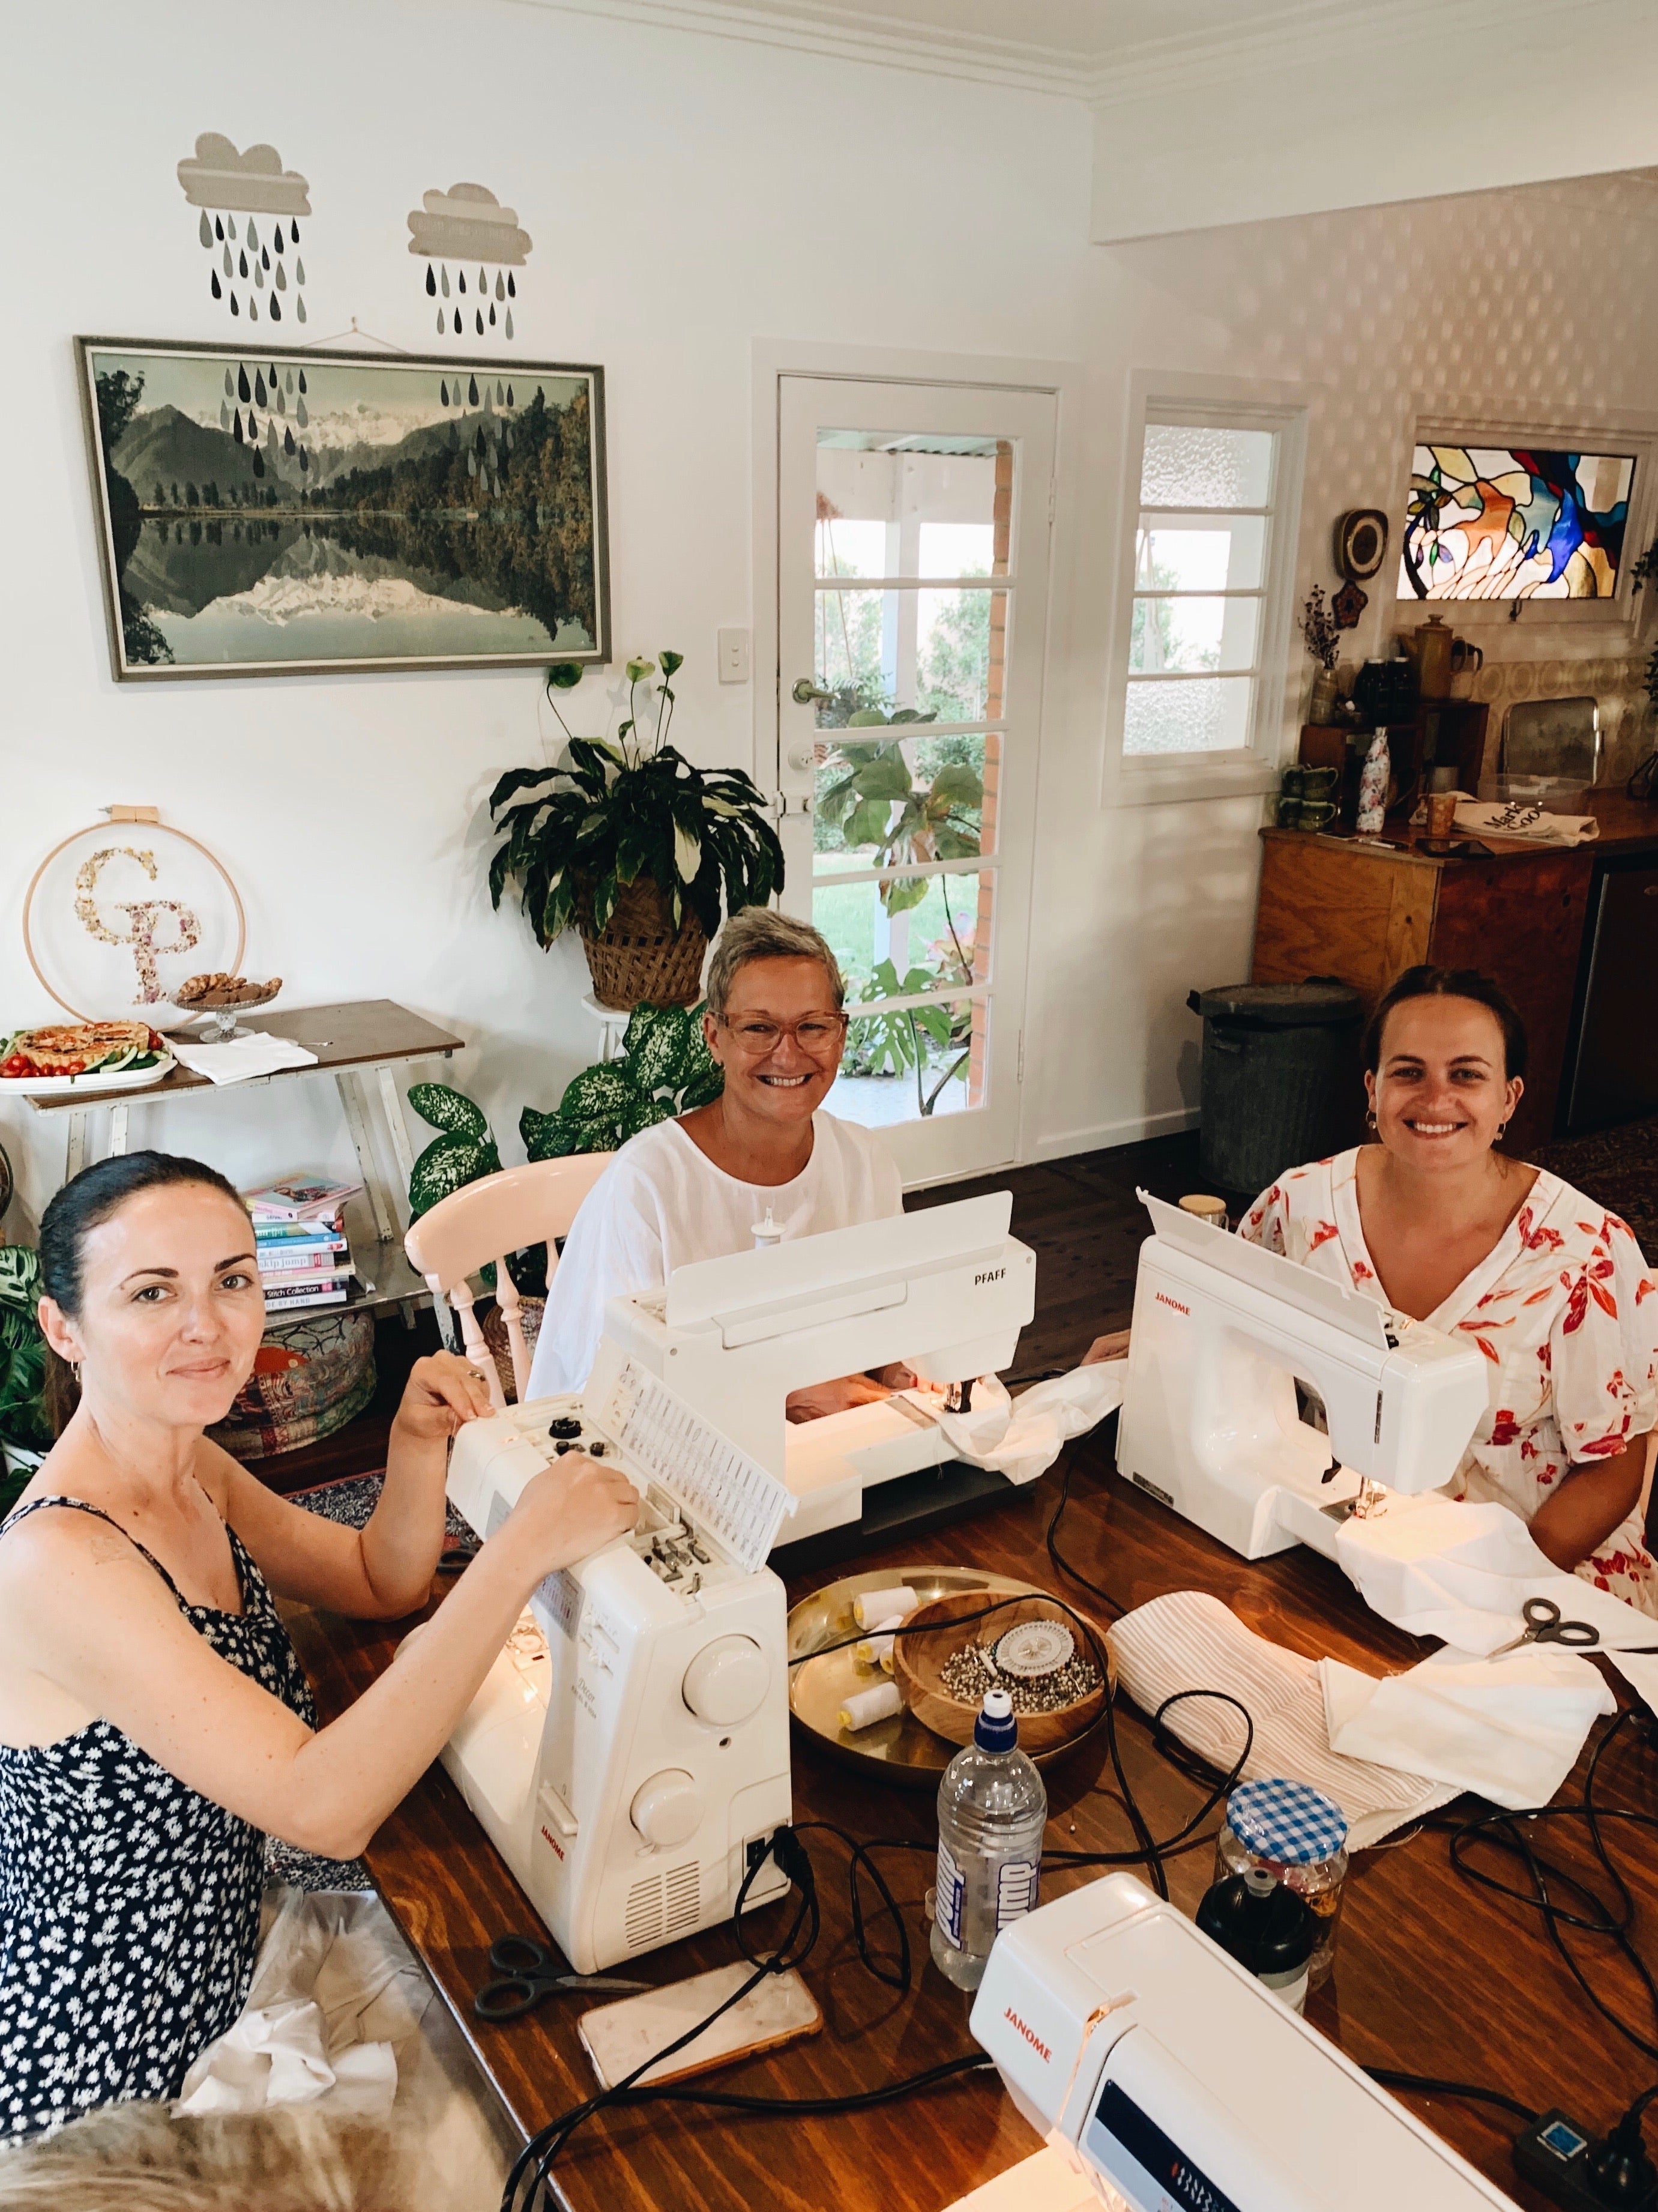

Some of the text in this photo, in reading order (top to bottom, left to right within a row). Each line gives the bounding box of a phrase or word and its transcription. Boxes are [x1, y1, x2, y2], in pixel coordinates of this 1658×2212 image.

[267, 1286, 319, 1298] Stitch Collection
[974, 1268, 1006, 1286] PFAFF
[1154, 1292, 1191, 1317] JANOME
[541, 1825, 565, 1863] JANOME
[996, 1862, 1037, 1931] ump
[1004, 2007, 1052, 2064] JANOME
